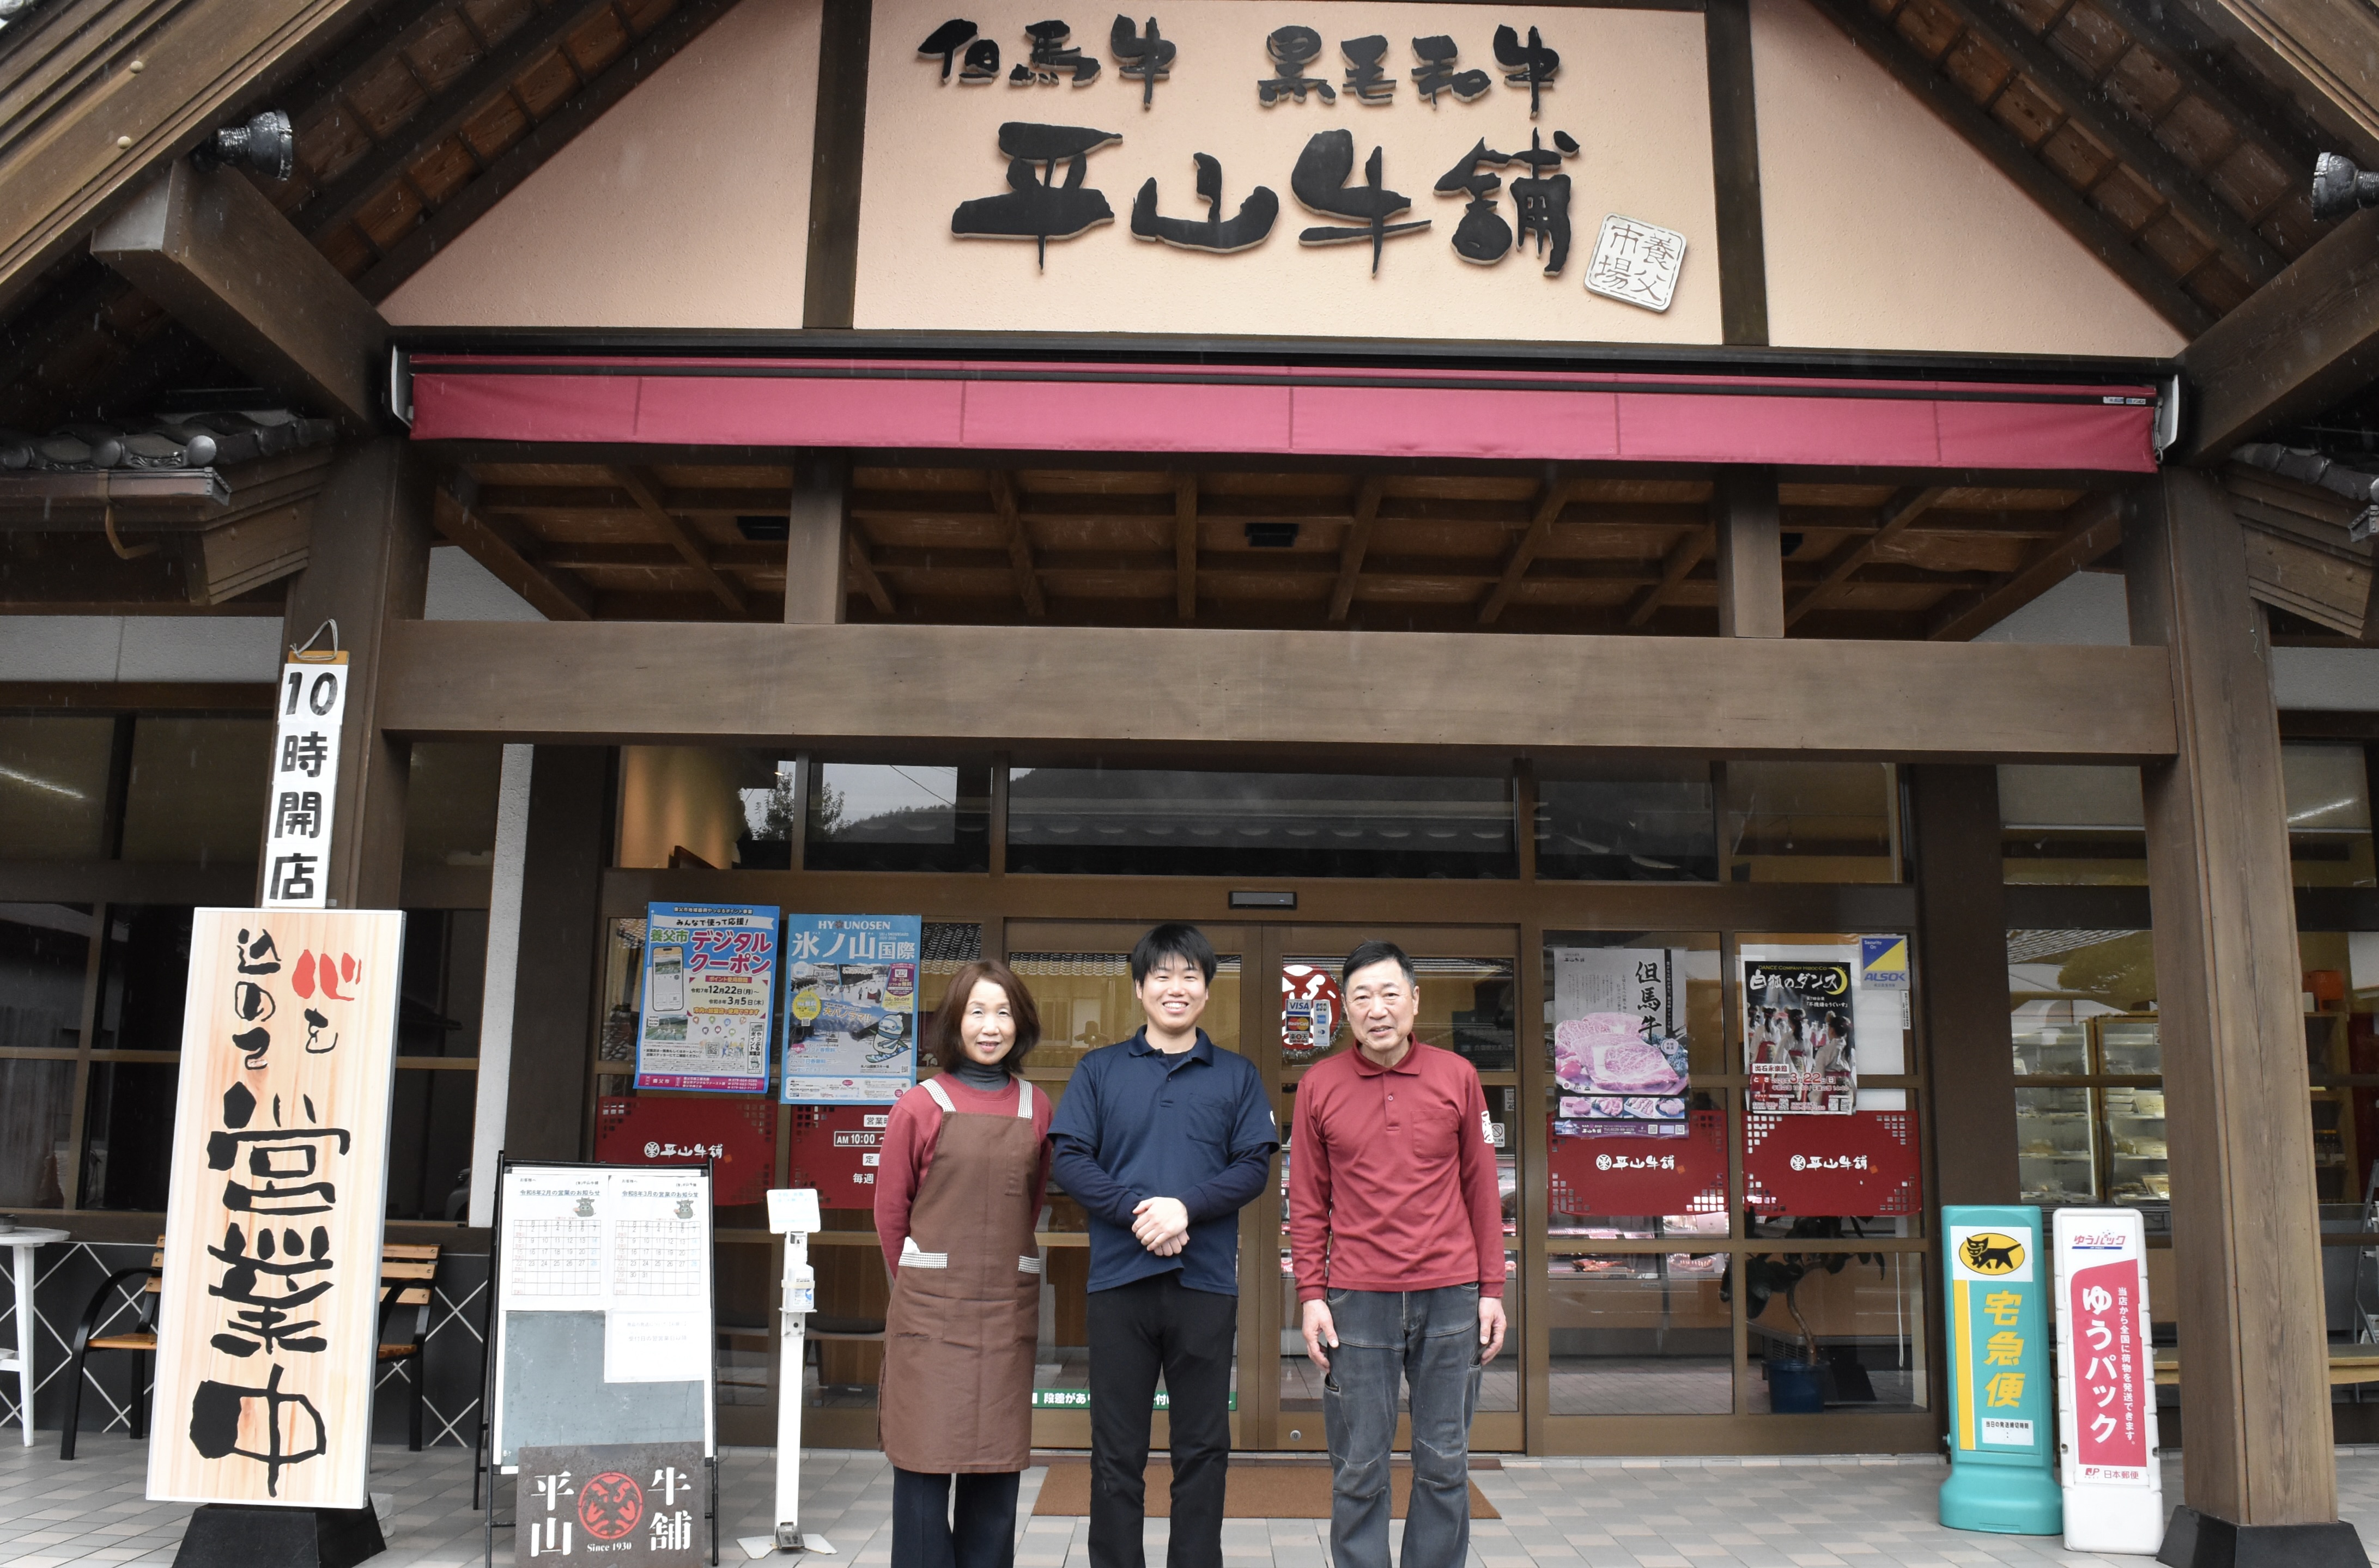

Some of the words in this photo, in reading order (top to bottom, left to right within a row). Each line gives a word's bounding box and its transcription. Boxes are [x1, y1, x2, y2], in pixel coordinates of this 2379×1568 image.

[918, 14, 1176, 109] 但馬牛
[1258, 24, 1561, 119] 黒毛和牛
[951, 123, 1580, 277] 平山牛舗
[269, 672, 338, 900] 10時開店
[651, 928, 689, 943] 養父市
[691, 930, 772, 952] デジタル
[689, 953, 771, 974] クーポン
[1750, 969, 1838, 990] 白狐のダンス
[1864, 973, 1905, 981] ALSOK
[1289, 1002, 1309, 1010] VISA
[1635, 961, 1662, 1041] 但馬牛
[836, 1136, 848, 1144] AM
[851, 1134, 875, 1144] 10:00
[660, 1144, 723, 1159] 平山牛舗
[1612, 1154, 1674, 1171] 平山牛舗
[1806, 1155, 1868, 1171] 平山牛舗
[853, 1173, 874, 1184] 毎週
[2073, 1234, 2126, 1245] ゆうパック
[190, 1081, 350, 1497] 営業中
[1983, 1290, 2026, 1408] 宅急便
[2082, 1285, 2117, 1443] ゆうパック
[2118, 1287, 2135, 1445] 当店から全国に荷物を発送できます。
[2104, 1470, 2139, 1480] 日本郵便
[531, 1471, 574, 1557] 平山
[648, 1467, 692, 1551] 牛舗
[587, 1543, 610, 1552] Since
[612, 1542, 632, 1551] 1930
